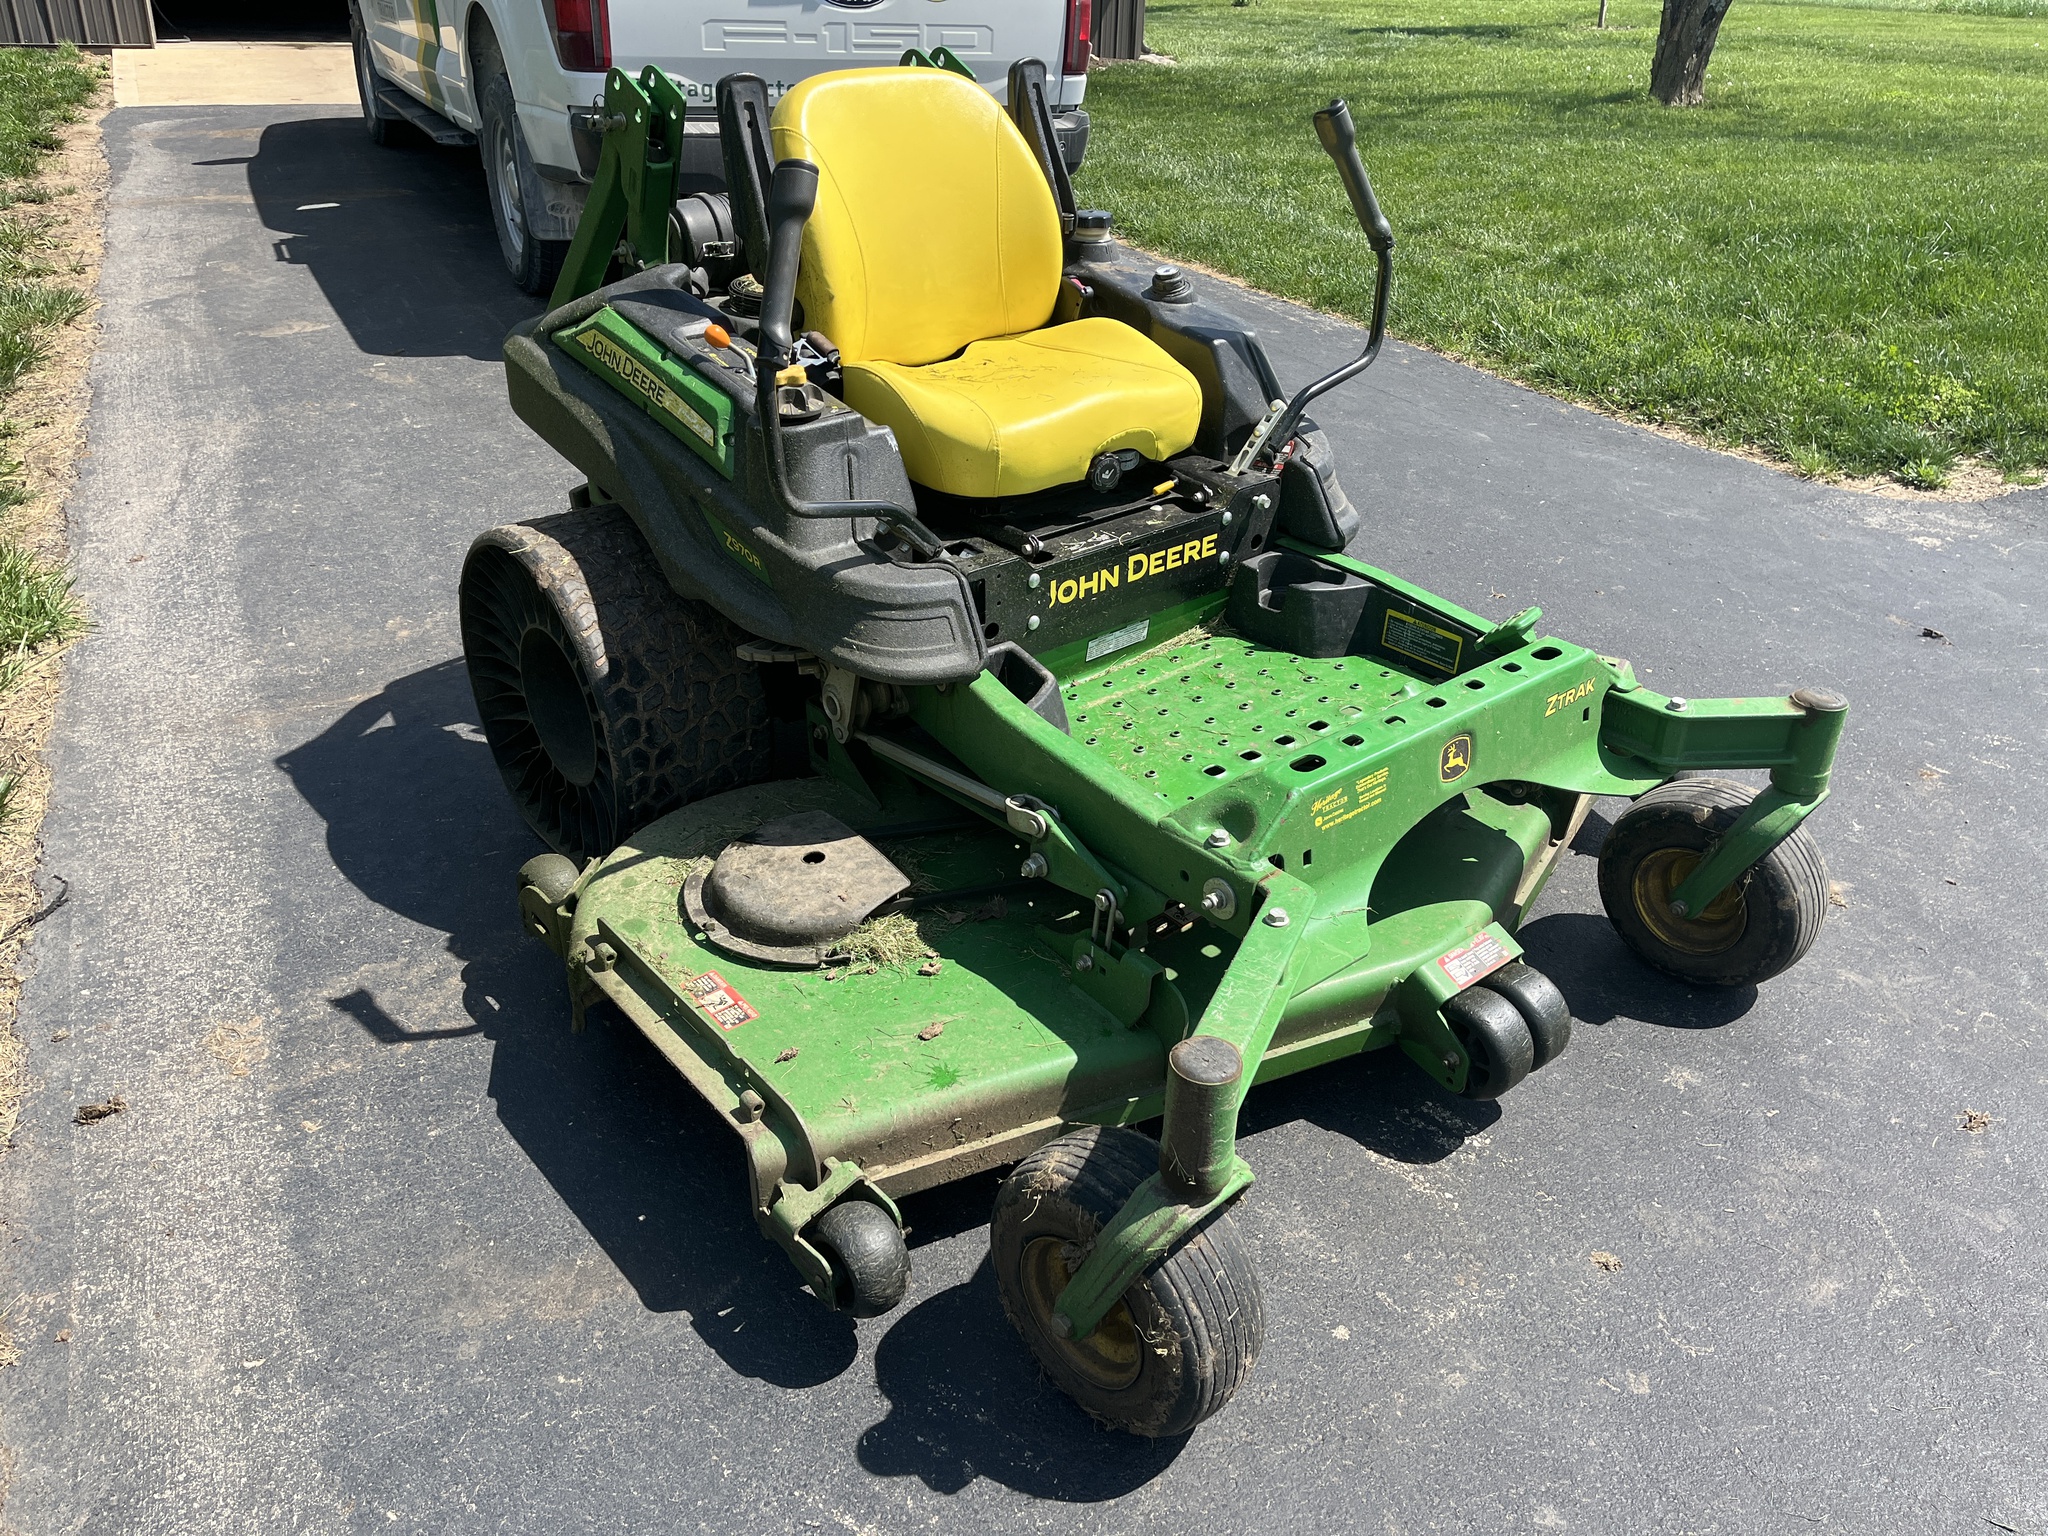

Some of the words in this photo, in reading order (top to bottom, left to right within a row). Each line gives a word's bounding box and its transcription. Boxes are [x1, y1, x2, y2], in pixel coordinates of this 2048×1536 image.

[701, 18, 994, 54] F-150
[586, 333, 622, 372] JOHN
[622, 356, 666, 406] DEERE
[723, 530, 762, 571] Z970R
[1049, 565, 1120, 609] JOHN
[1127, 533, 1219, 583] DEERE
[1544, 676, 1597, 719] ZTRAK
[1322, 795, 1348, 813] TRACTOR
